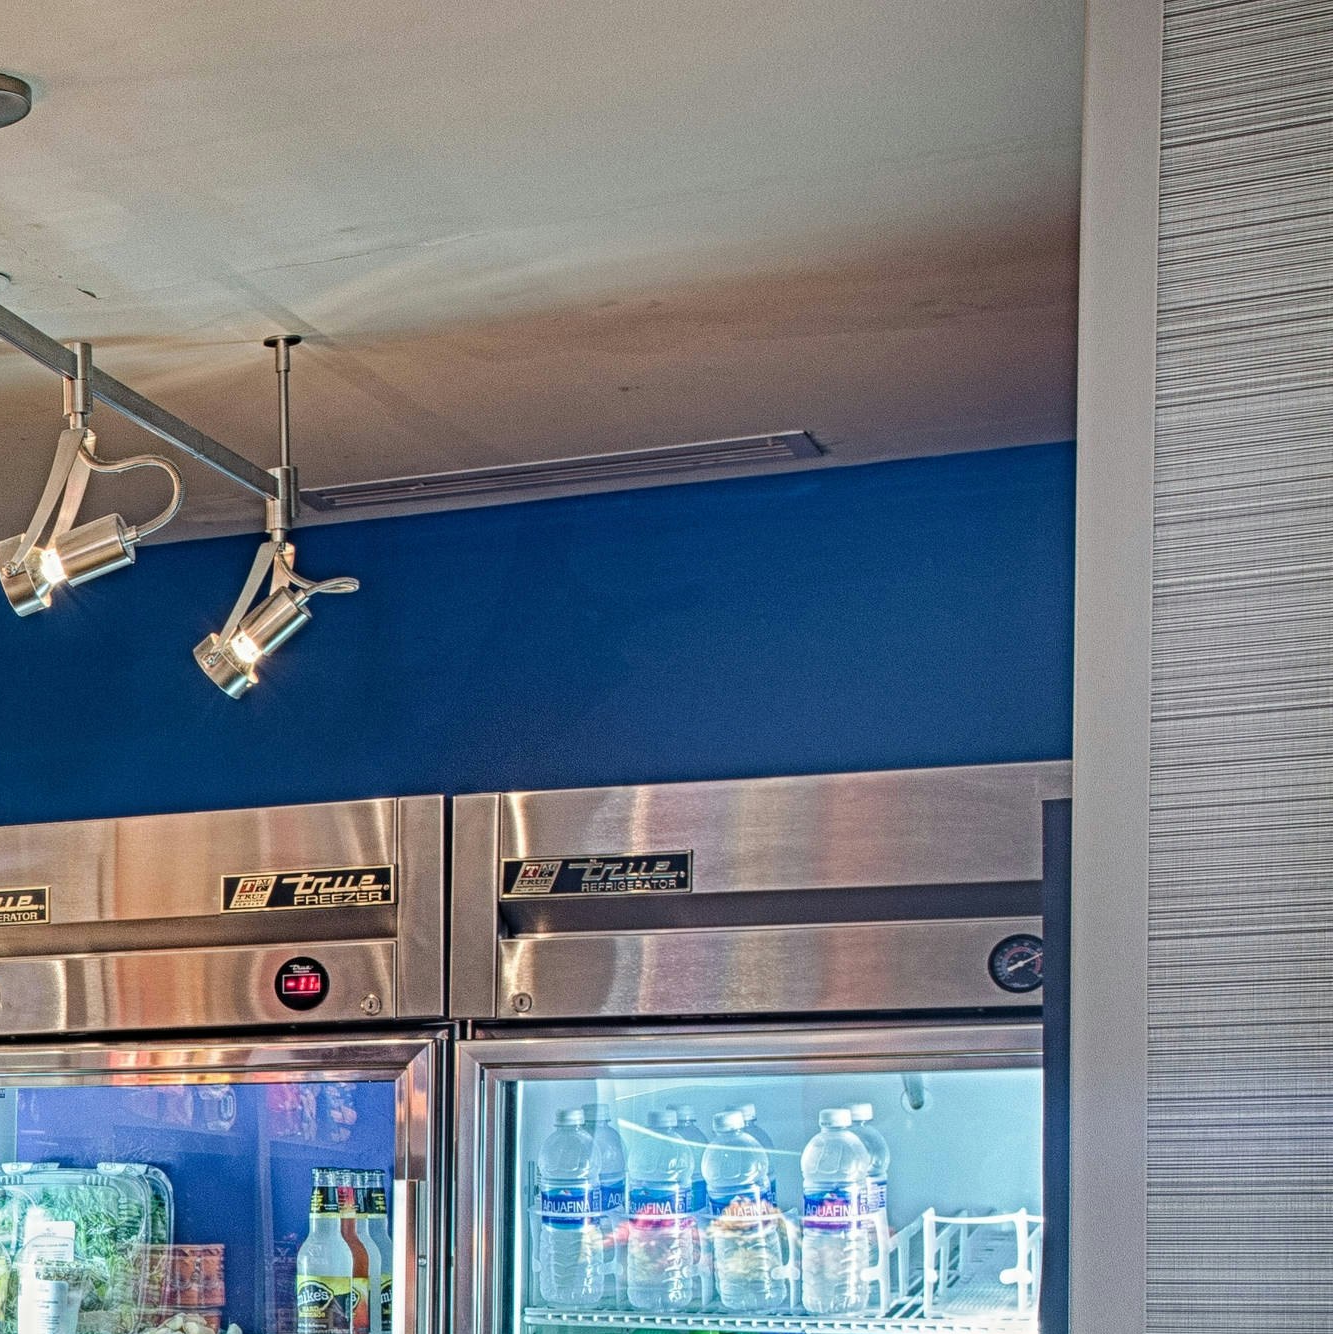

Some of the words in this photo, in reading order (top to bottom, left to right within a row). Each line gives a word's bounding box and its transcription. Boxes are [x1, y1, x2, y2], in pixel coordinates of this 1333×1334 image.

[568, 859, 678, 881] true
[282, 873, 384, 896] true
[581, 879, 677, 893] REFRIGERATOR
[293, 891, 382, 906] FREEZER
[542, 1199, 591, 1213] AQUAFINA
